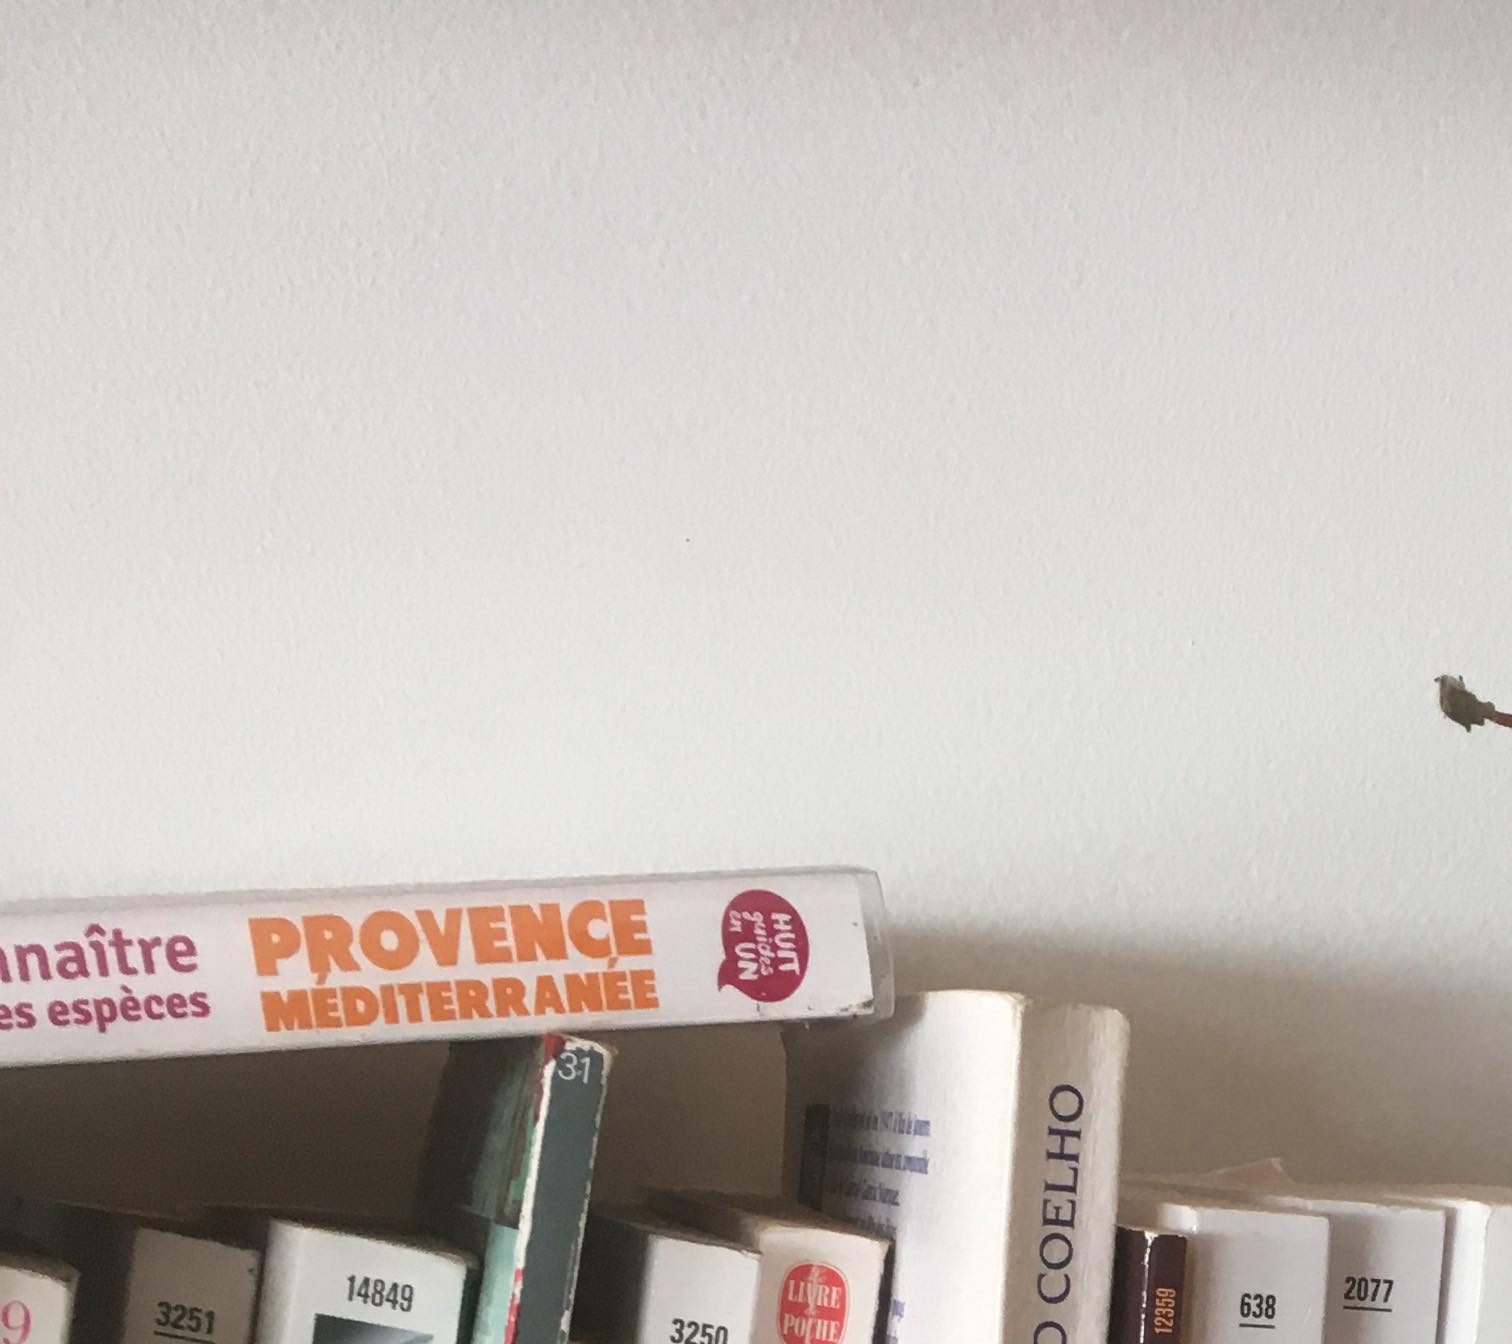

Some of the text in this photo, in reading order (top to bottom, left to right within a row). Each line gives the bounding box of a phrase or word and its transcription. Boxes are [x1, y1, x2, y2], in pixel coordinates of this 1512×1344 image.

[248, 898, 654, 977] PROVENCE
[771, 911, 801, 976] HUIT
[734, 941, 760, 981] UN
[47, 985, 211, 1034] espèces
[260, 957, 660, 1033] MÉDITERRANÉE
[556, 1052, 591, 1084] 31
[1036, 1083, 1085, 1305] COELHO
[346, 1273, 415, 1313] 14849
[1154, 1287, 1177, 1334] 12359
[1240, 1293, 1277, 1320] 638
[1344, 1275, 1395, 1304] 2077
[155, 1301, 217, 1335] 3251
